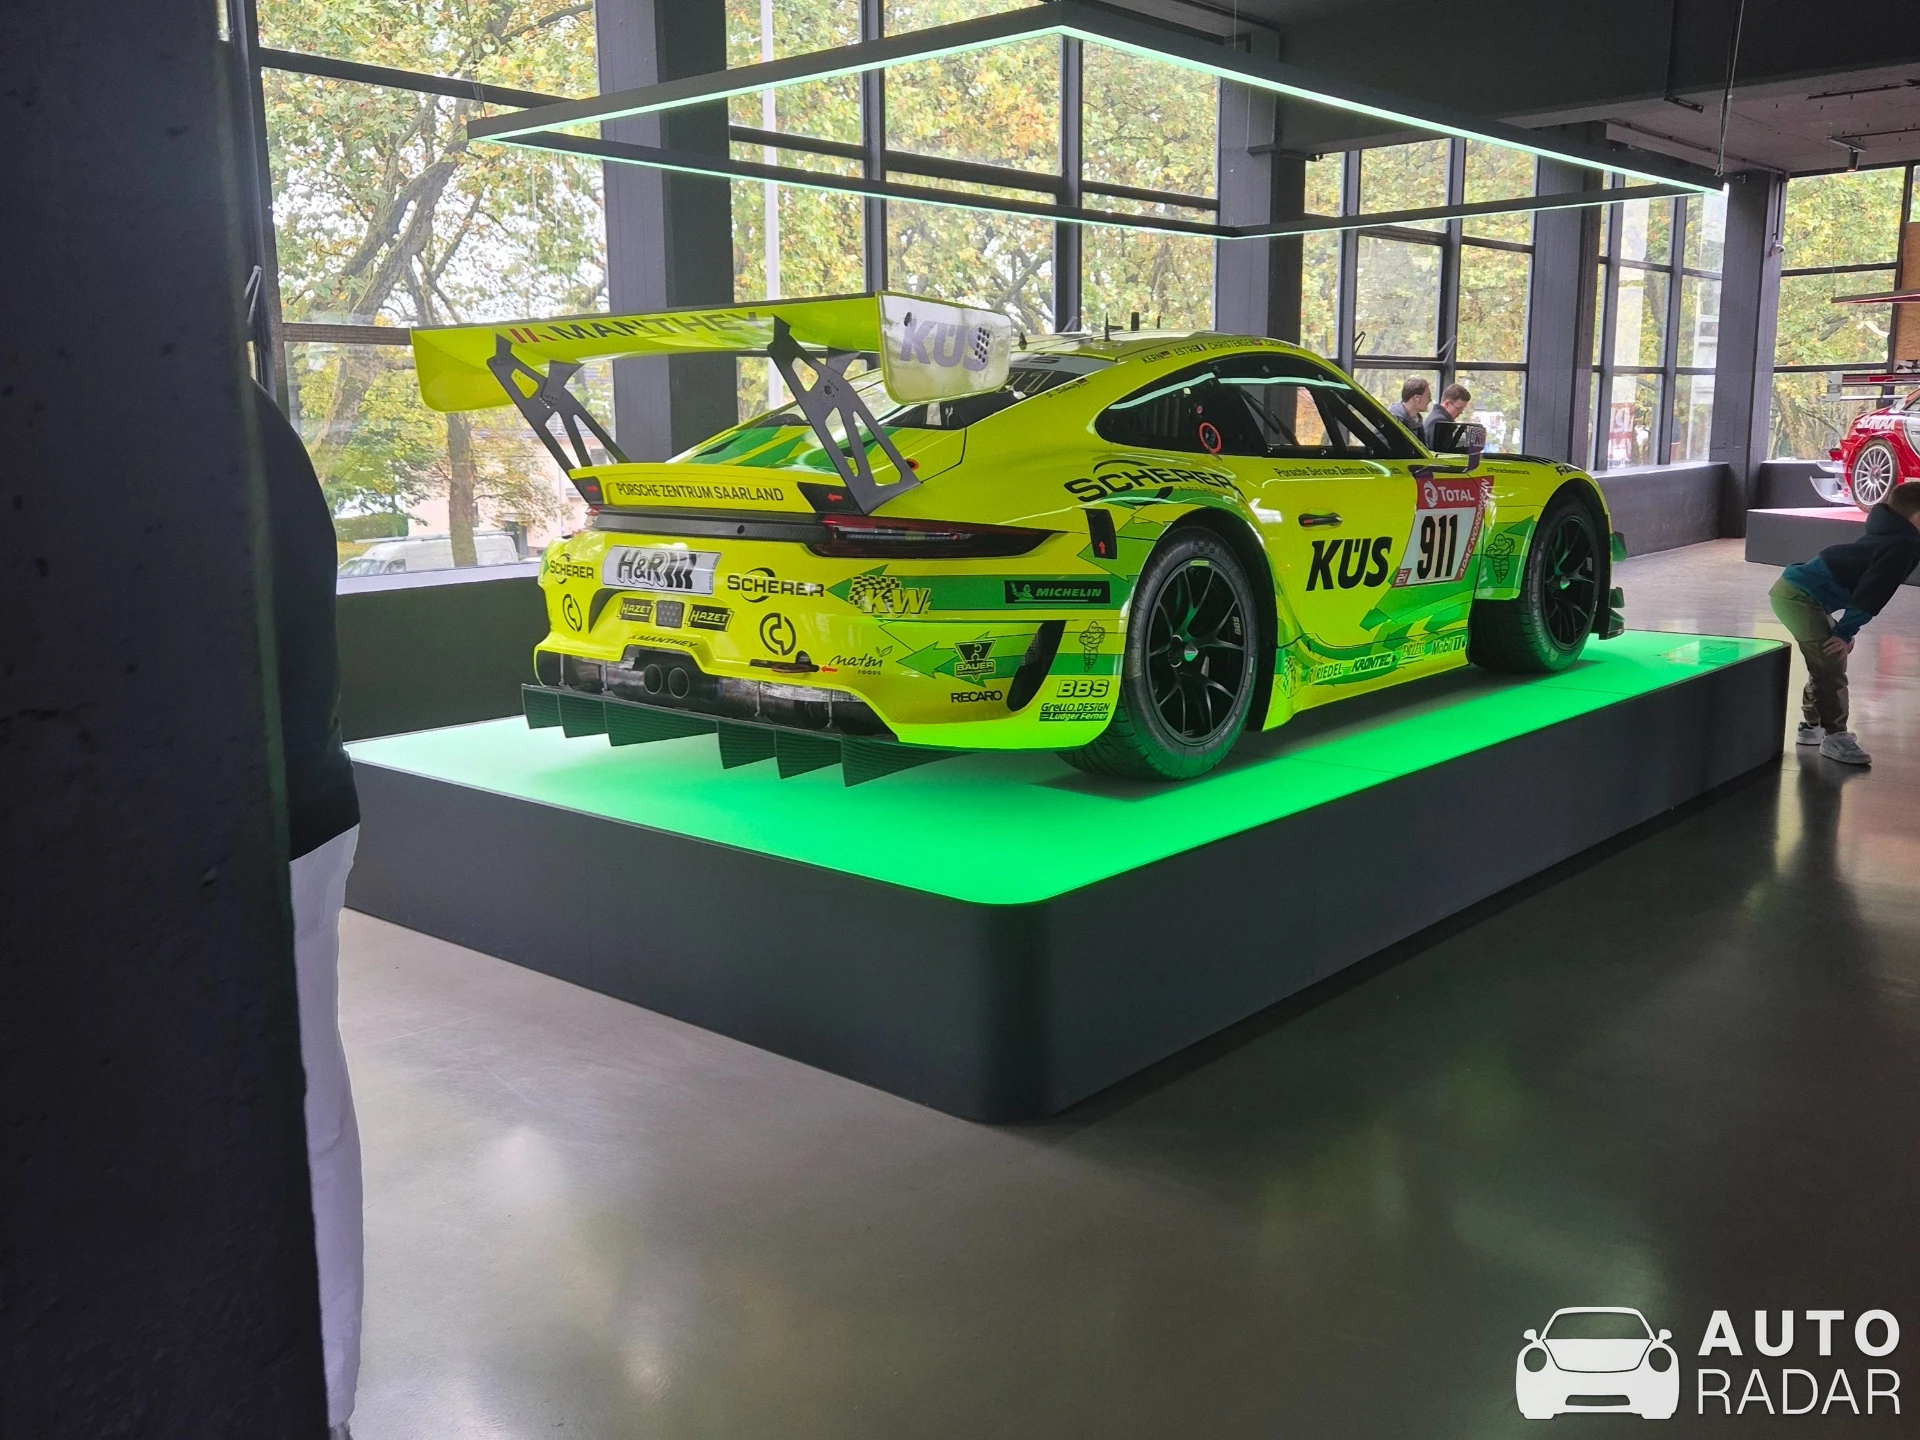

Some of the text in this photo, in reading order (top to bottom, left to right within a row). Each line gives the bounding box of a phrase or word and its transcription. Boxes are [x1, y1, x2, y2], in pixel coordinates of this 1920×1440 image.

[553, 312, 762, 342] MANTHEY
[899, 315, 991, 373] KÜS
[616, 483, 784, 502] PORSCHE ZENTRUM SAARLAND
[1064, 468, 1246, 503] SCHERER
[1416, 514, 1459, 580] 911
[549, 560, 595, 580] SCHERER
[616, 547, 669, 586] H&R
[1305, 535, 1393, 592] KÜS
[1459, 544, 1473, 578] ADAC
[727, 574, 825, 598] SCHERER
[1035, 588, 1103, 598] MICHELIN
[621, 603, 652, 615] HAZET
[861, 587, 930, 615] KW
[690, 610, 729, 623] HAZET
[637, 634, 698, 648] MANTHEY
[957, 660, 994, 673] BAUER
[1316, 663, 1343, 680] RIEDEL
[951, 690, 1003, 703] RECARO
[1056, 679, 1110, 698] BBS
[1049, 712, 1080, 722] Ludger
